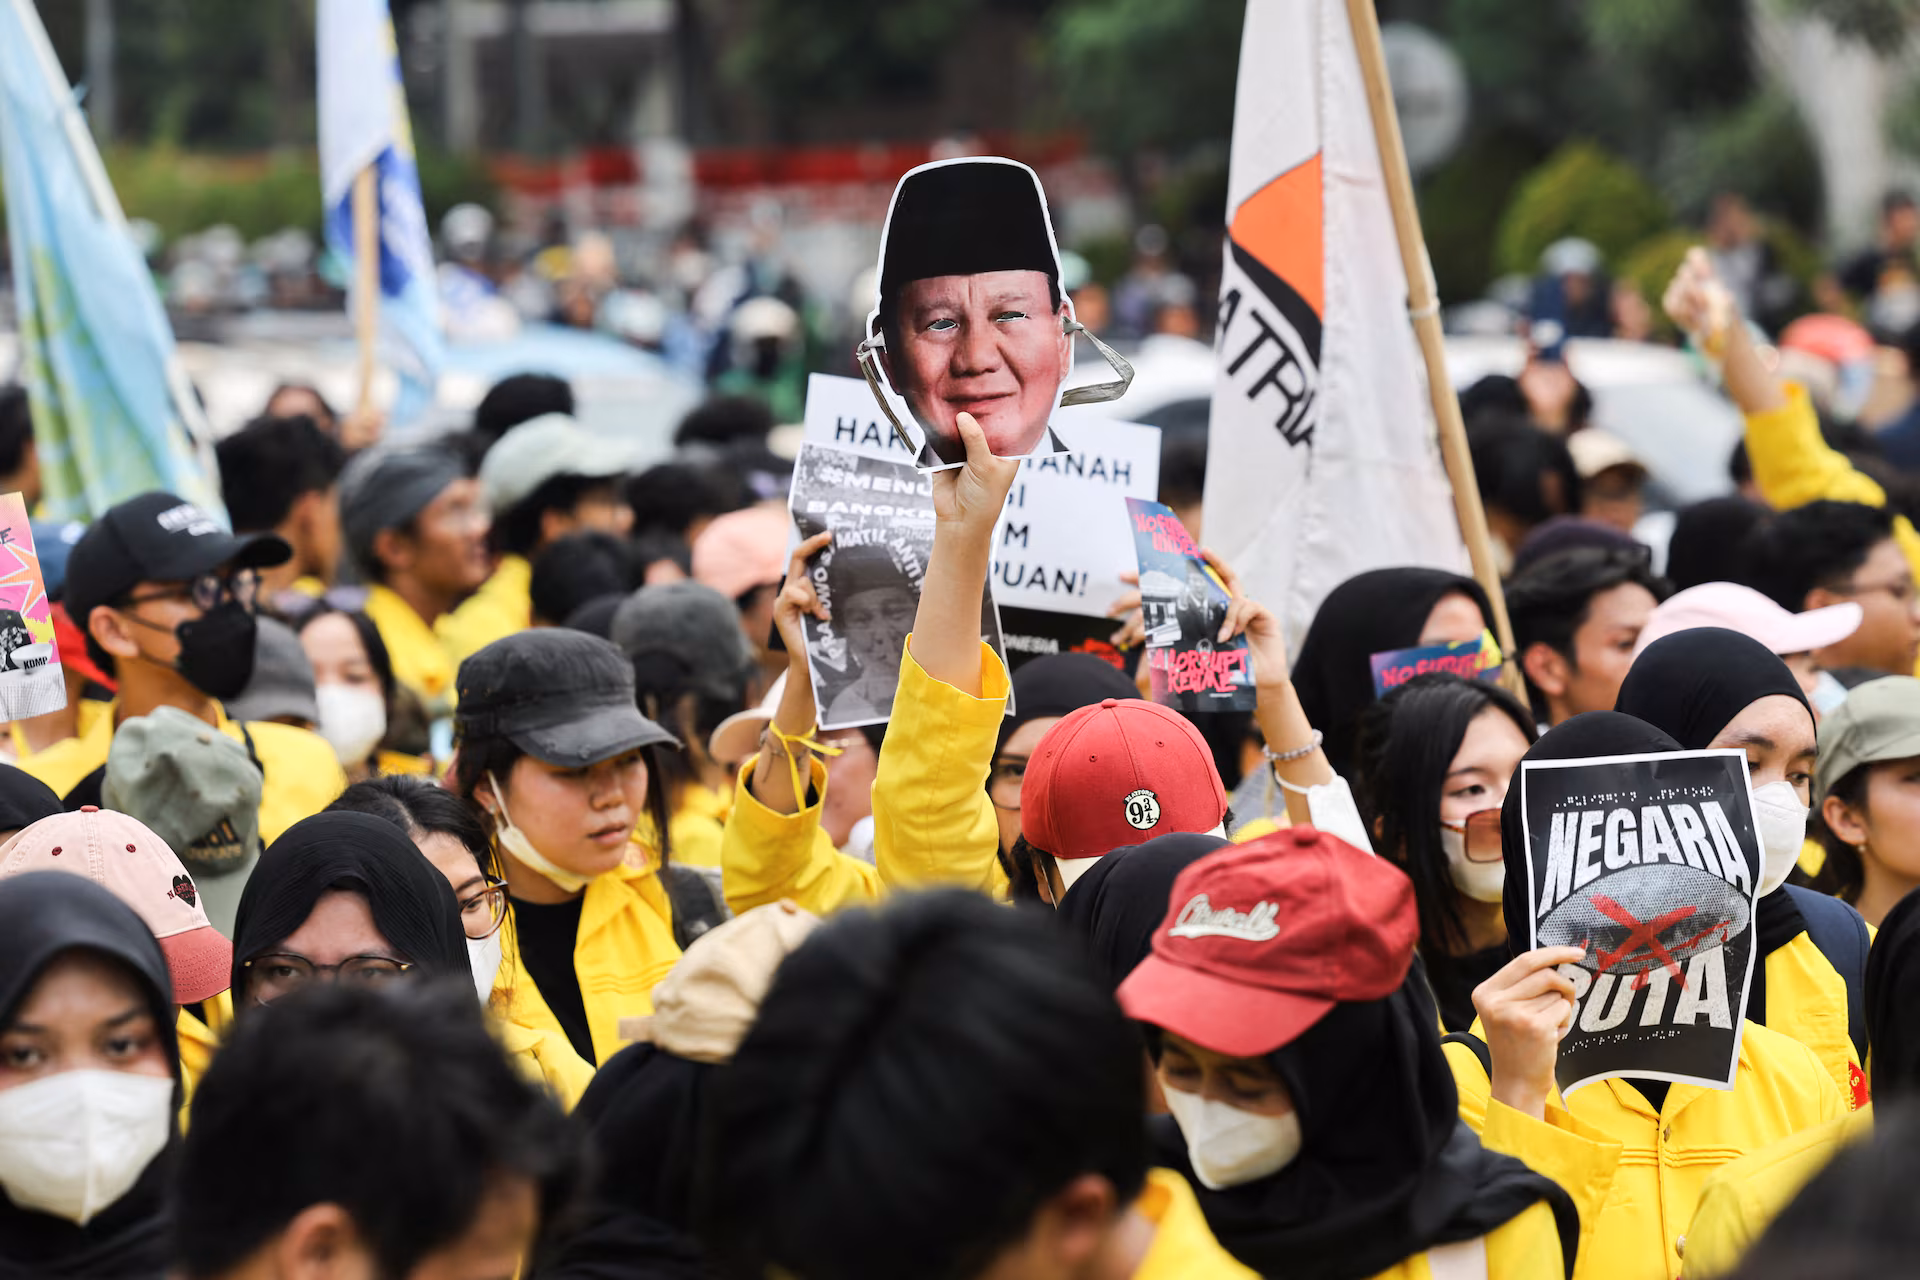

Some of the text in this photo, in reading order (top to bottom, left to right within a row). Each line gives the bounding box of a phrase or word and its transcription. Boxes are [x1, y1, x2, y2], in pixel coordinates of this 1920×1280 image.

[994, 561, 1088, 597] UAN!
[814, 566, 842, 659] PRAOWO
[23, 656, 48, 670] KDMP
[1538, 801, 1751, 919] NEGARA
